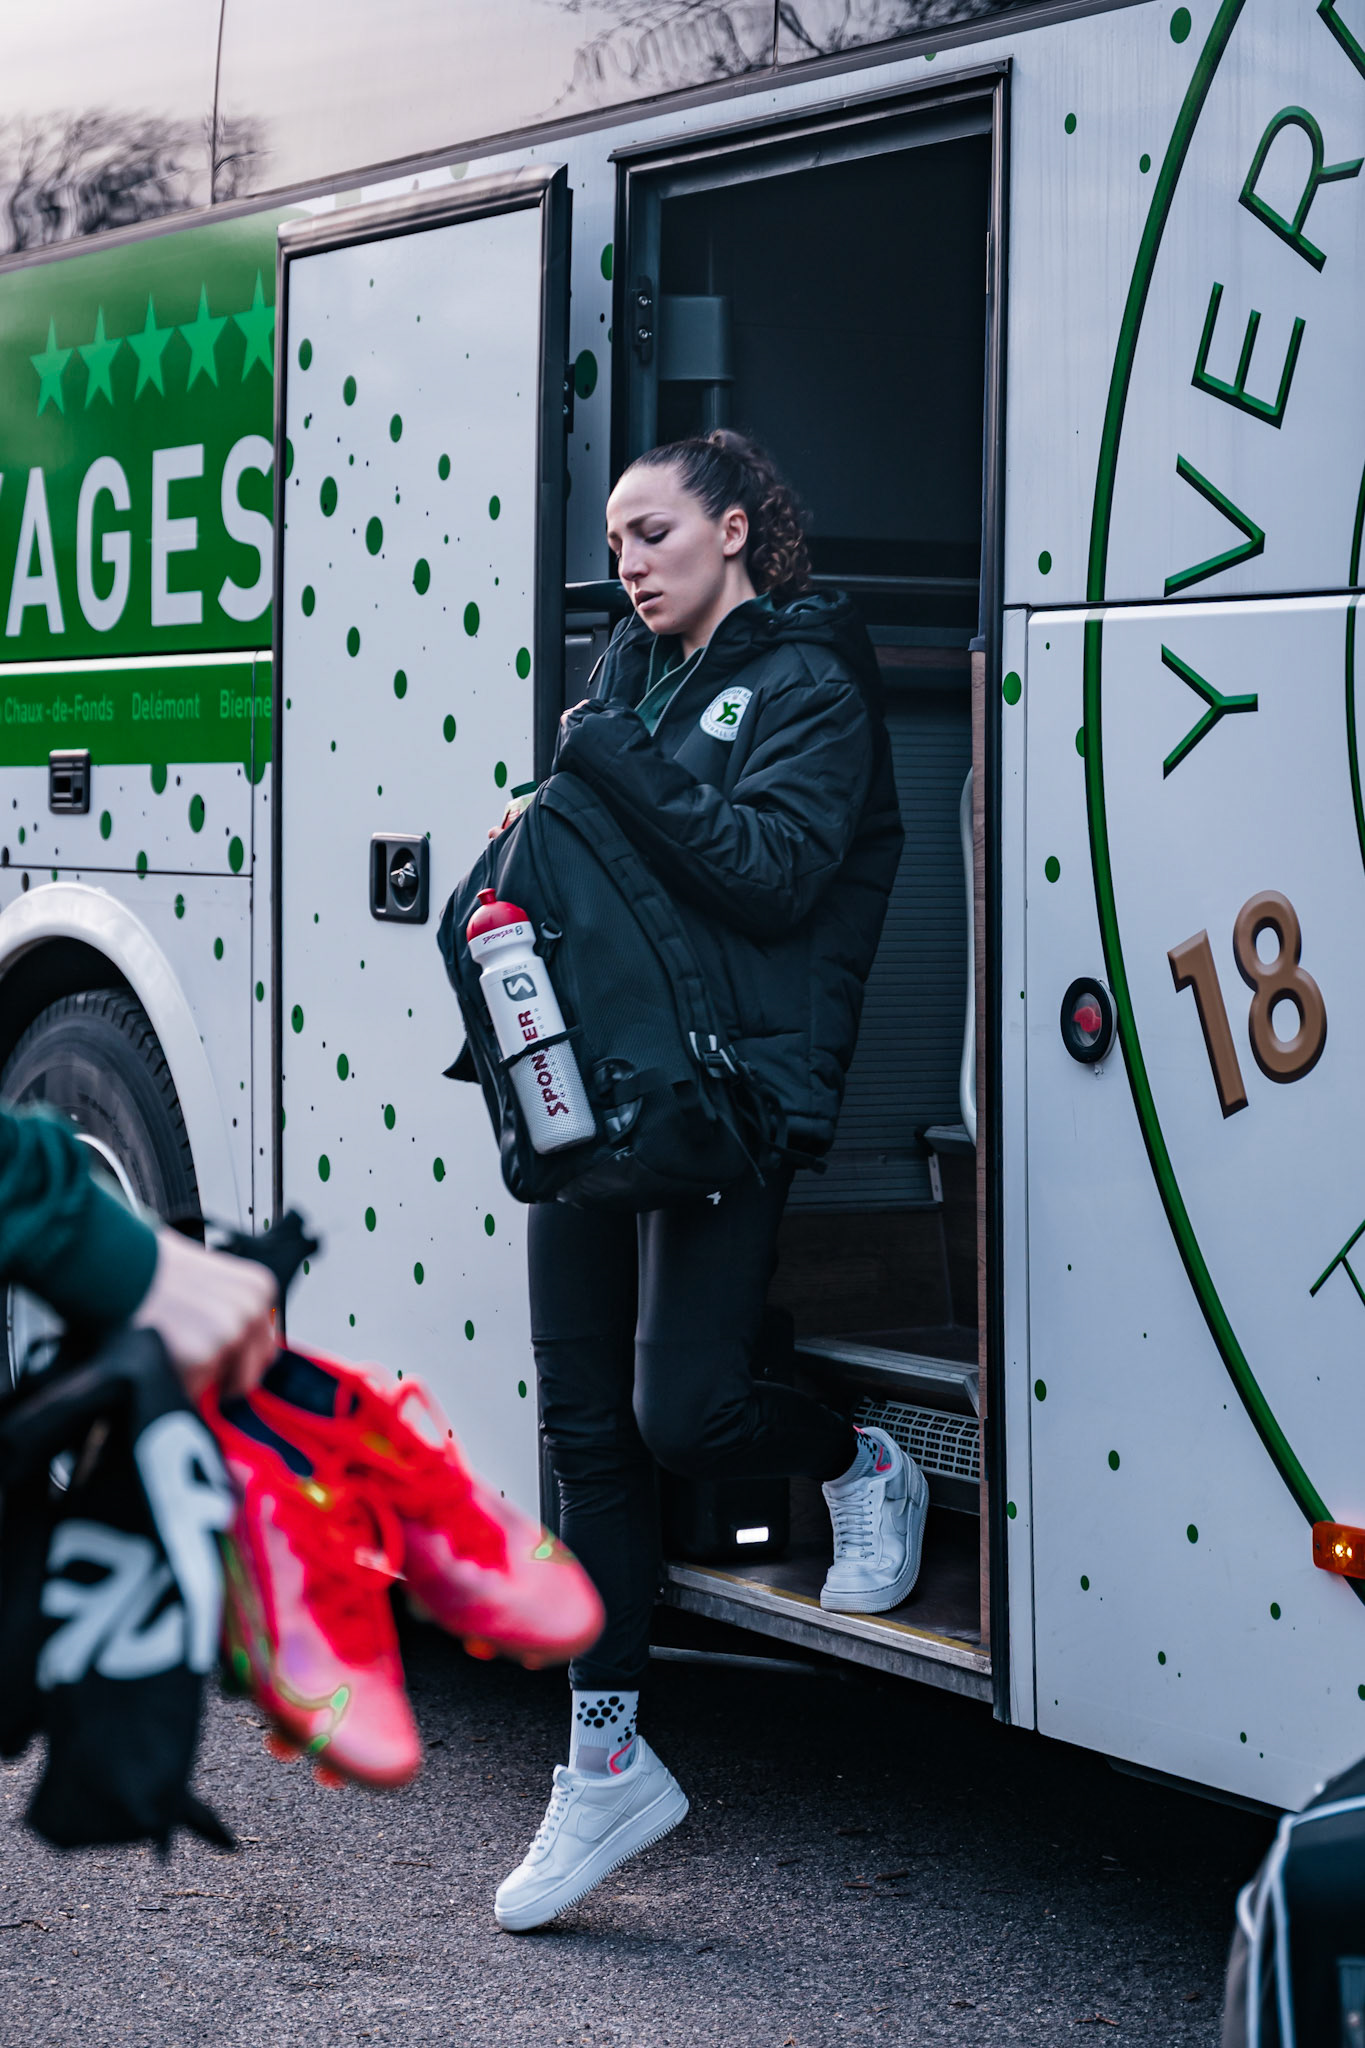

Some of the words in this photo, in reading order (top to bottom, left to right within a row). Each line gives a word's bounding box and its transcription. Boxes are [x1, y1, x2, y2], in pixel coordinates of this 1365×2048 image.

[0, 434, 274, 637] AGES
[131, 690, 200, 721] Delémont
[219, 689, 272, 719] Bienne
[518, 1010, 569, 1117] SPONER
[1167, 889, 1328, 1121] 18
